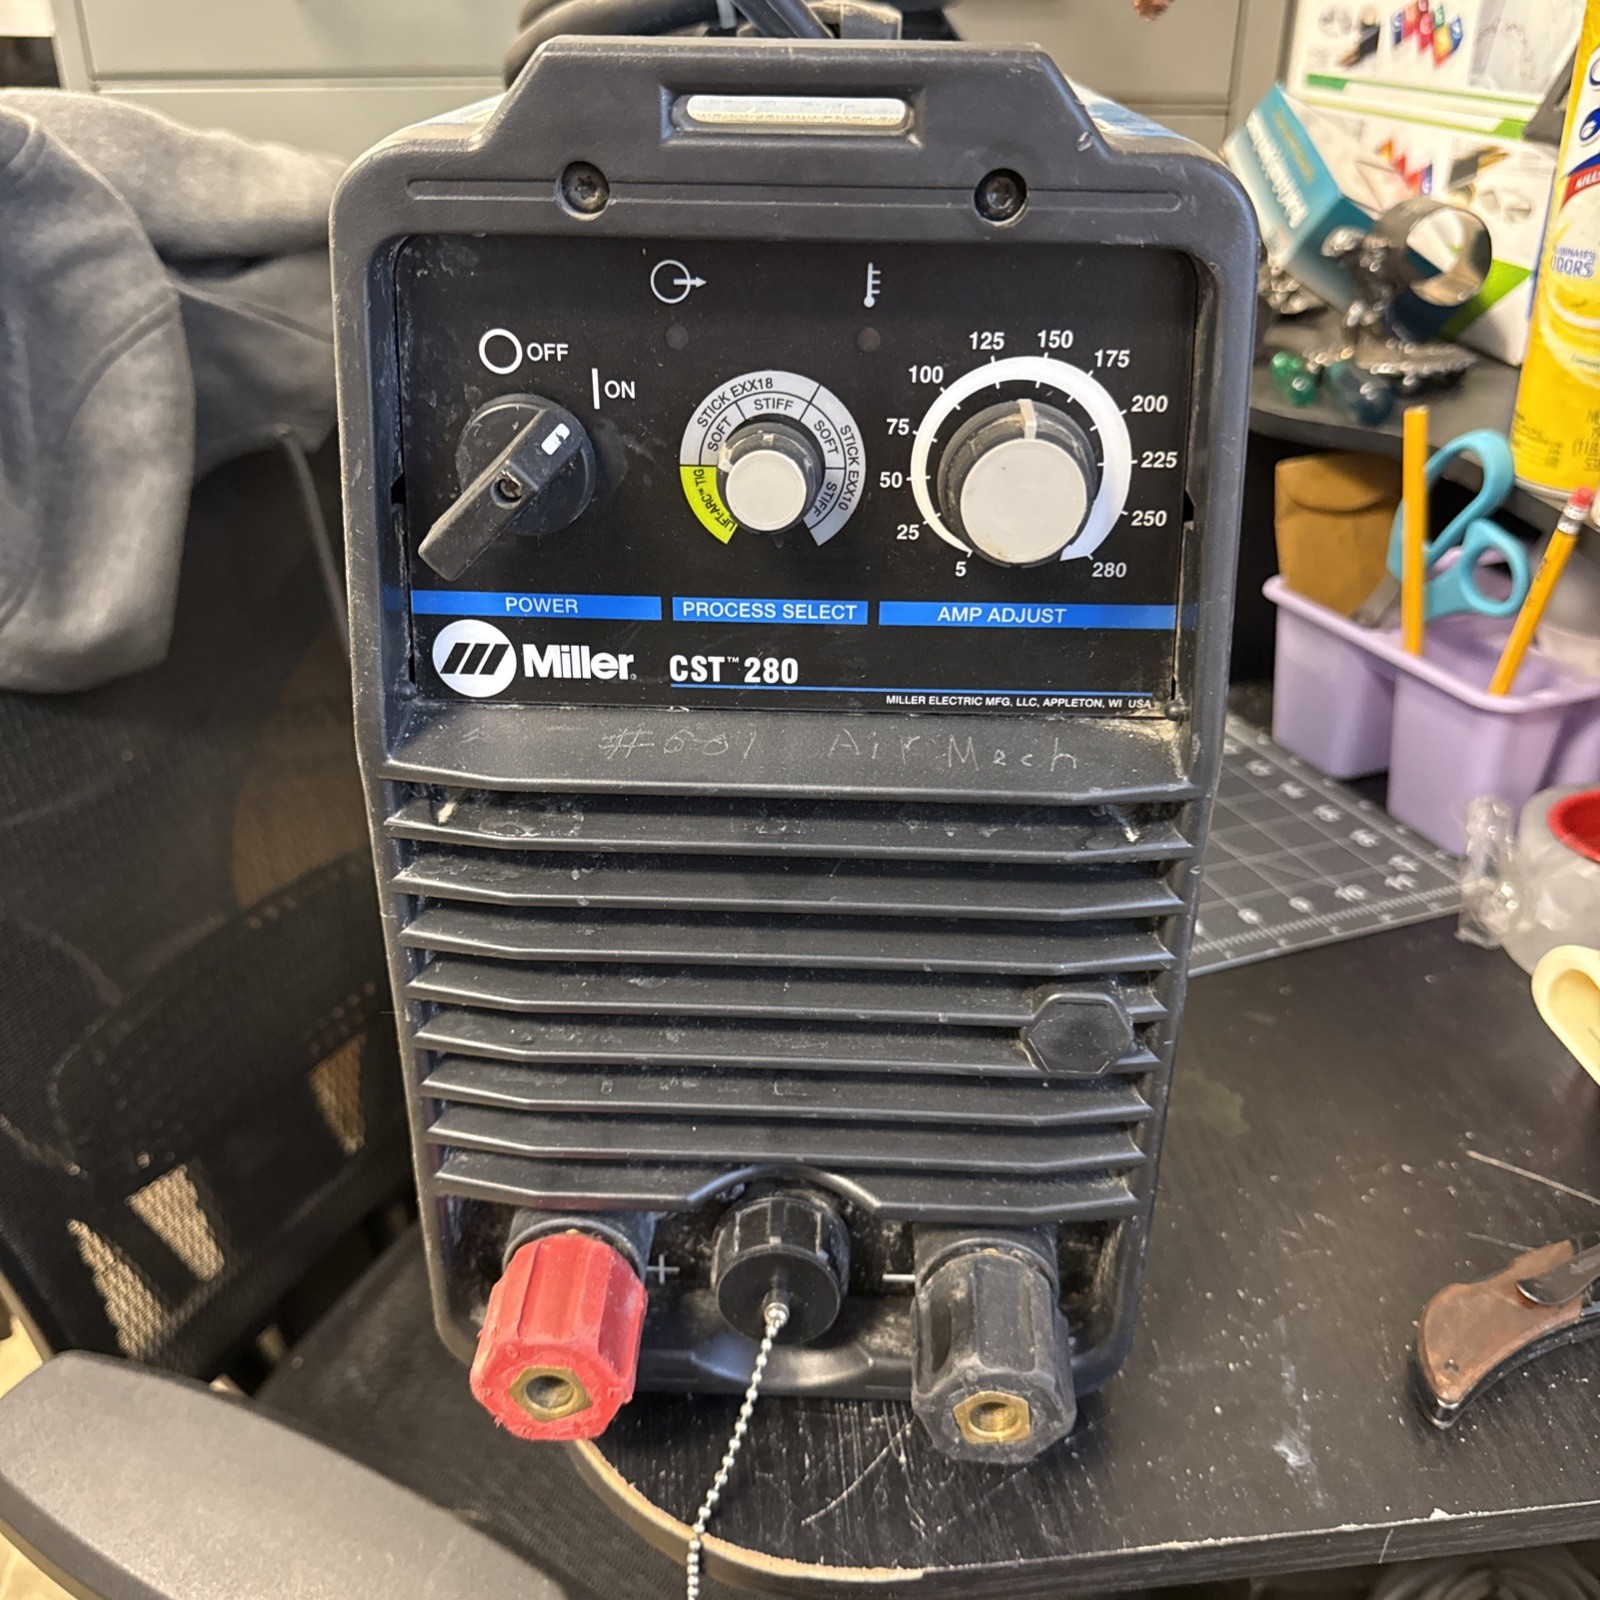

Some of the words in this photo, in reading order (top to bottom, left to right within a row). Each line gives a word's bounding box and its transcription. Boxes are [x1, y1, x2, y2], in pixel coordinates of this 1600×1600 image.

[969, 331, 1005, 351] 125
[1037, 330, 1074, 349] 150
[526, 342, 569, 362] OFF
[1094, 349, 1130, 368] 175
[908, 366, 944, 383] 100
[604, 380, 636, 399] ON
[697, 391, 731, 428] STICK
[730, 377, 773, 398] EXX18
[753, 397, 794, 411] STIFF
[1131, 395, 1168, 413] 200
[707, 415, 733, 452] SOFT
[886, 418, 910, 436] 75
[814, 420, 839, 455] SOFT
[840, 424, 860, 466] STICK
[1141, 451, 1178, 468] 225
[693, 468, 706, 487] TIG
[879, 472, 903, 489] 50
[813, 481, 838, 518] STIFF
[838, 470, 860, 511] EXX10
[1131, 510, 1167, 527] 250
[896, 523, 920, 541] 25
[955, 561, 967, 577] 5
[1091, 563, 1127, 578] 280
[505, 597, 579, 614] POWER
[683, 602, 776, 619] PROCESS
[782, 603, 857, 621] SELECT
[937, 607, 982, 622] AMP
[987, 607, 1067, 624] ADJUST
[744, 656, 799, 685] 280
[886, 695, 926, 705] MILLER
[928, 696, 983, 706] ELECTRIC
[985, 697, 1013, 707] MFG.
[1016, 697, 1040, 708] LLC,
[1042, 698, 1105, 709] APPLETON,
[1108, 698, 1122, 708] WI
[1128, 699, 1150, 709] USA
